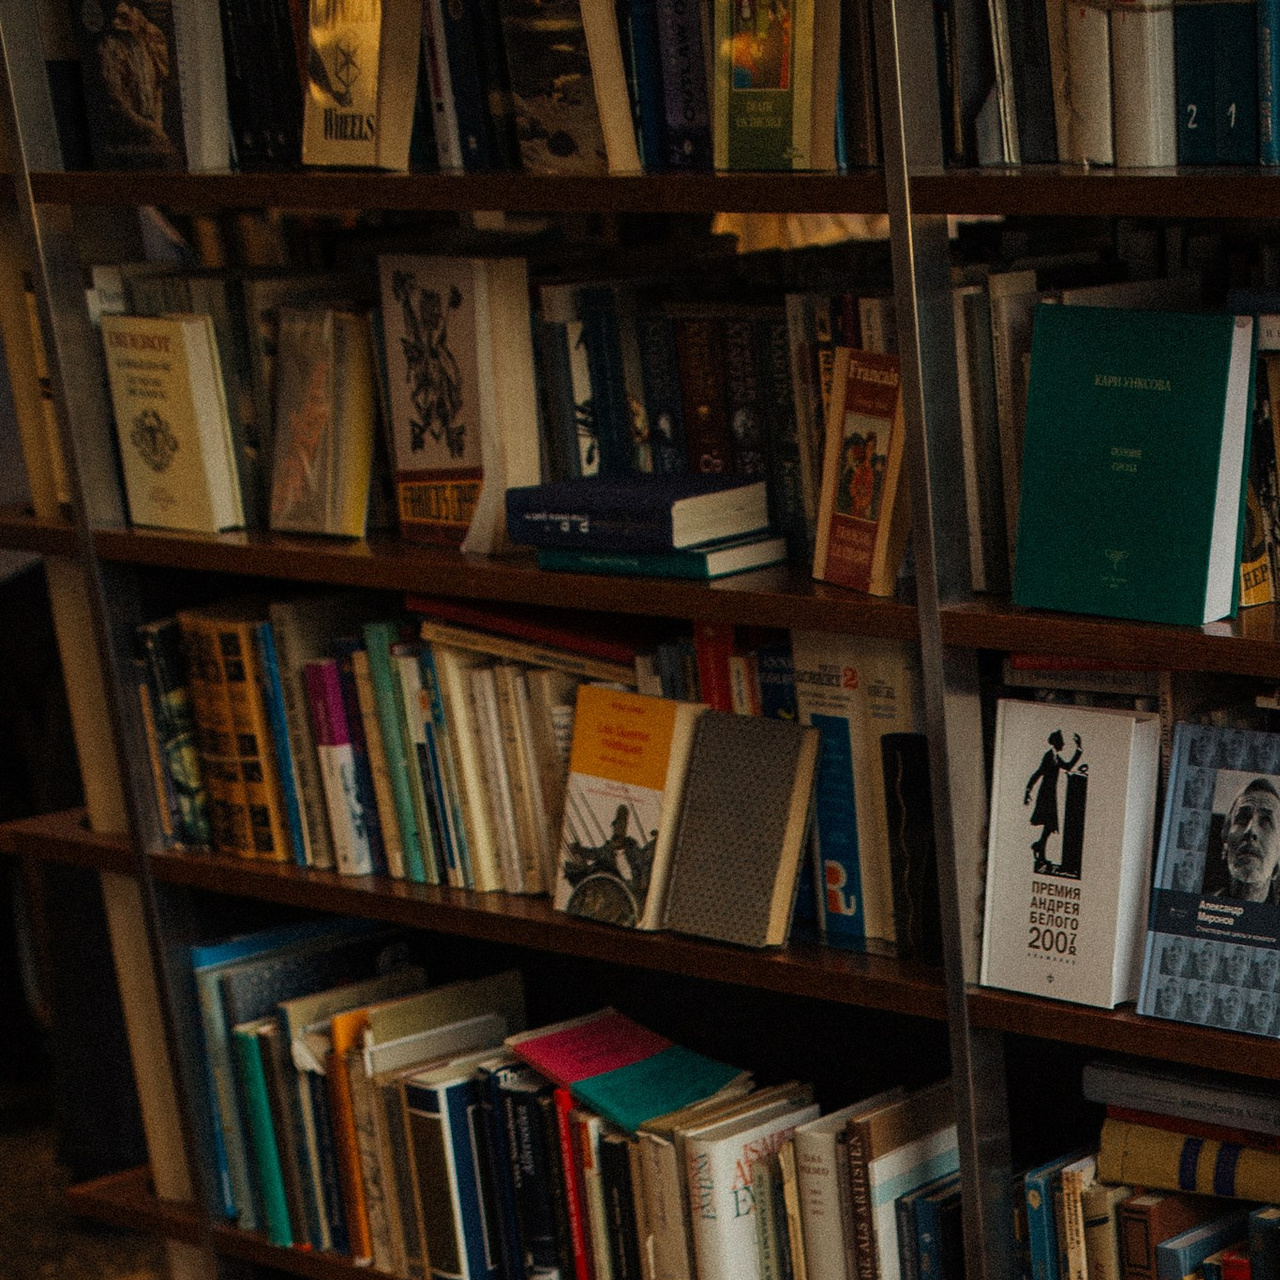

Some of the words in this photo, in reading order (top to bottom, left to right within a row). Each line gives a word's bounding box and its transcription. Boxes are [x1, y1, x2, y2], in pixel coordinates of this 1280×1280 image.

[1031, 880, 1081, 901] ПРЕМИЯ
[1030, 896, 1080, 915] АНДРЕЯ
[1029, 911, 1079, 932] БЕЛОГО
